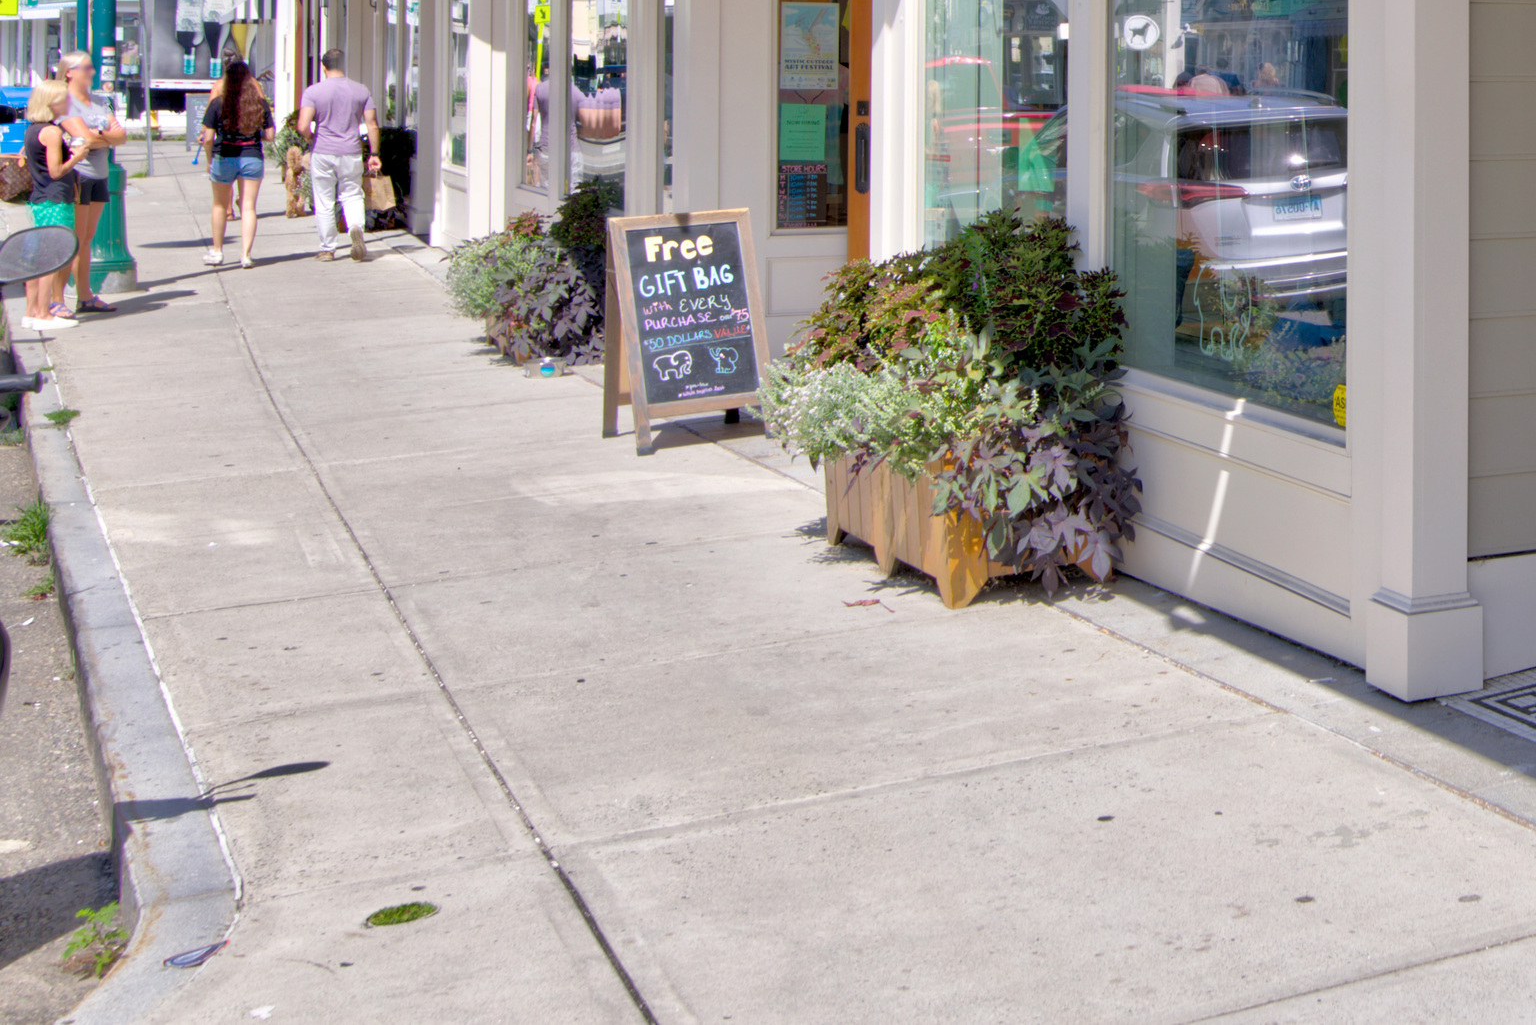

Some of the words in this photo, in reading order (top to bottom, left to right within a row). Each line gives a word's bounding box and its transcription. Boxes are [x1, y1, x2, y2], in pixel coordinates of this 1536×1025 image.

[782, 165, 803, 173] STORE
[803, 164, 826, 173] HOURS
[644, 235, 714, 262] Free
[639, 269, 687, 297] GIFT
[693, 264, 734, 290] BAG
[642, 301, 673, 316] with
[680, 294, 732, 313] EVERY
[644, 311, 717, 331] PURCHASE
[667, 329, 713, 347] DOLLARS
